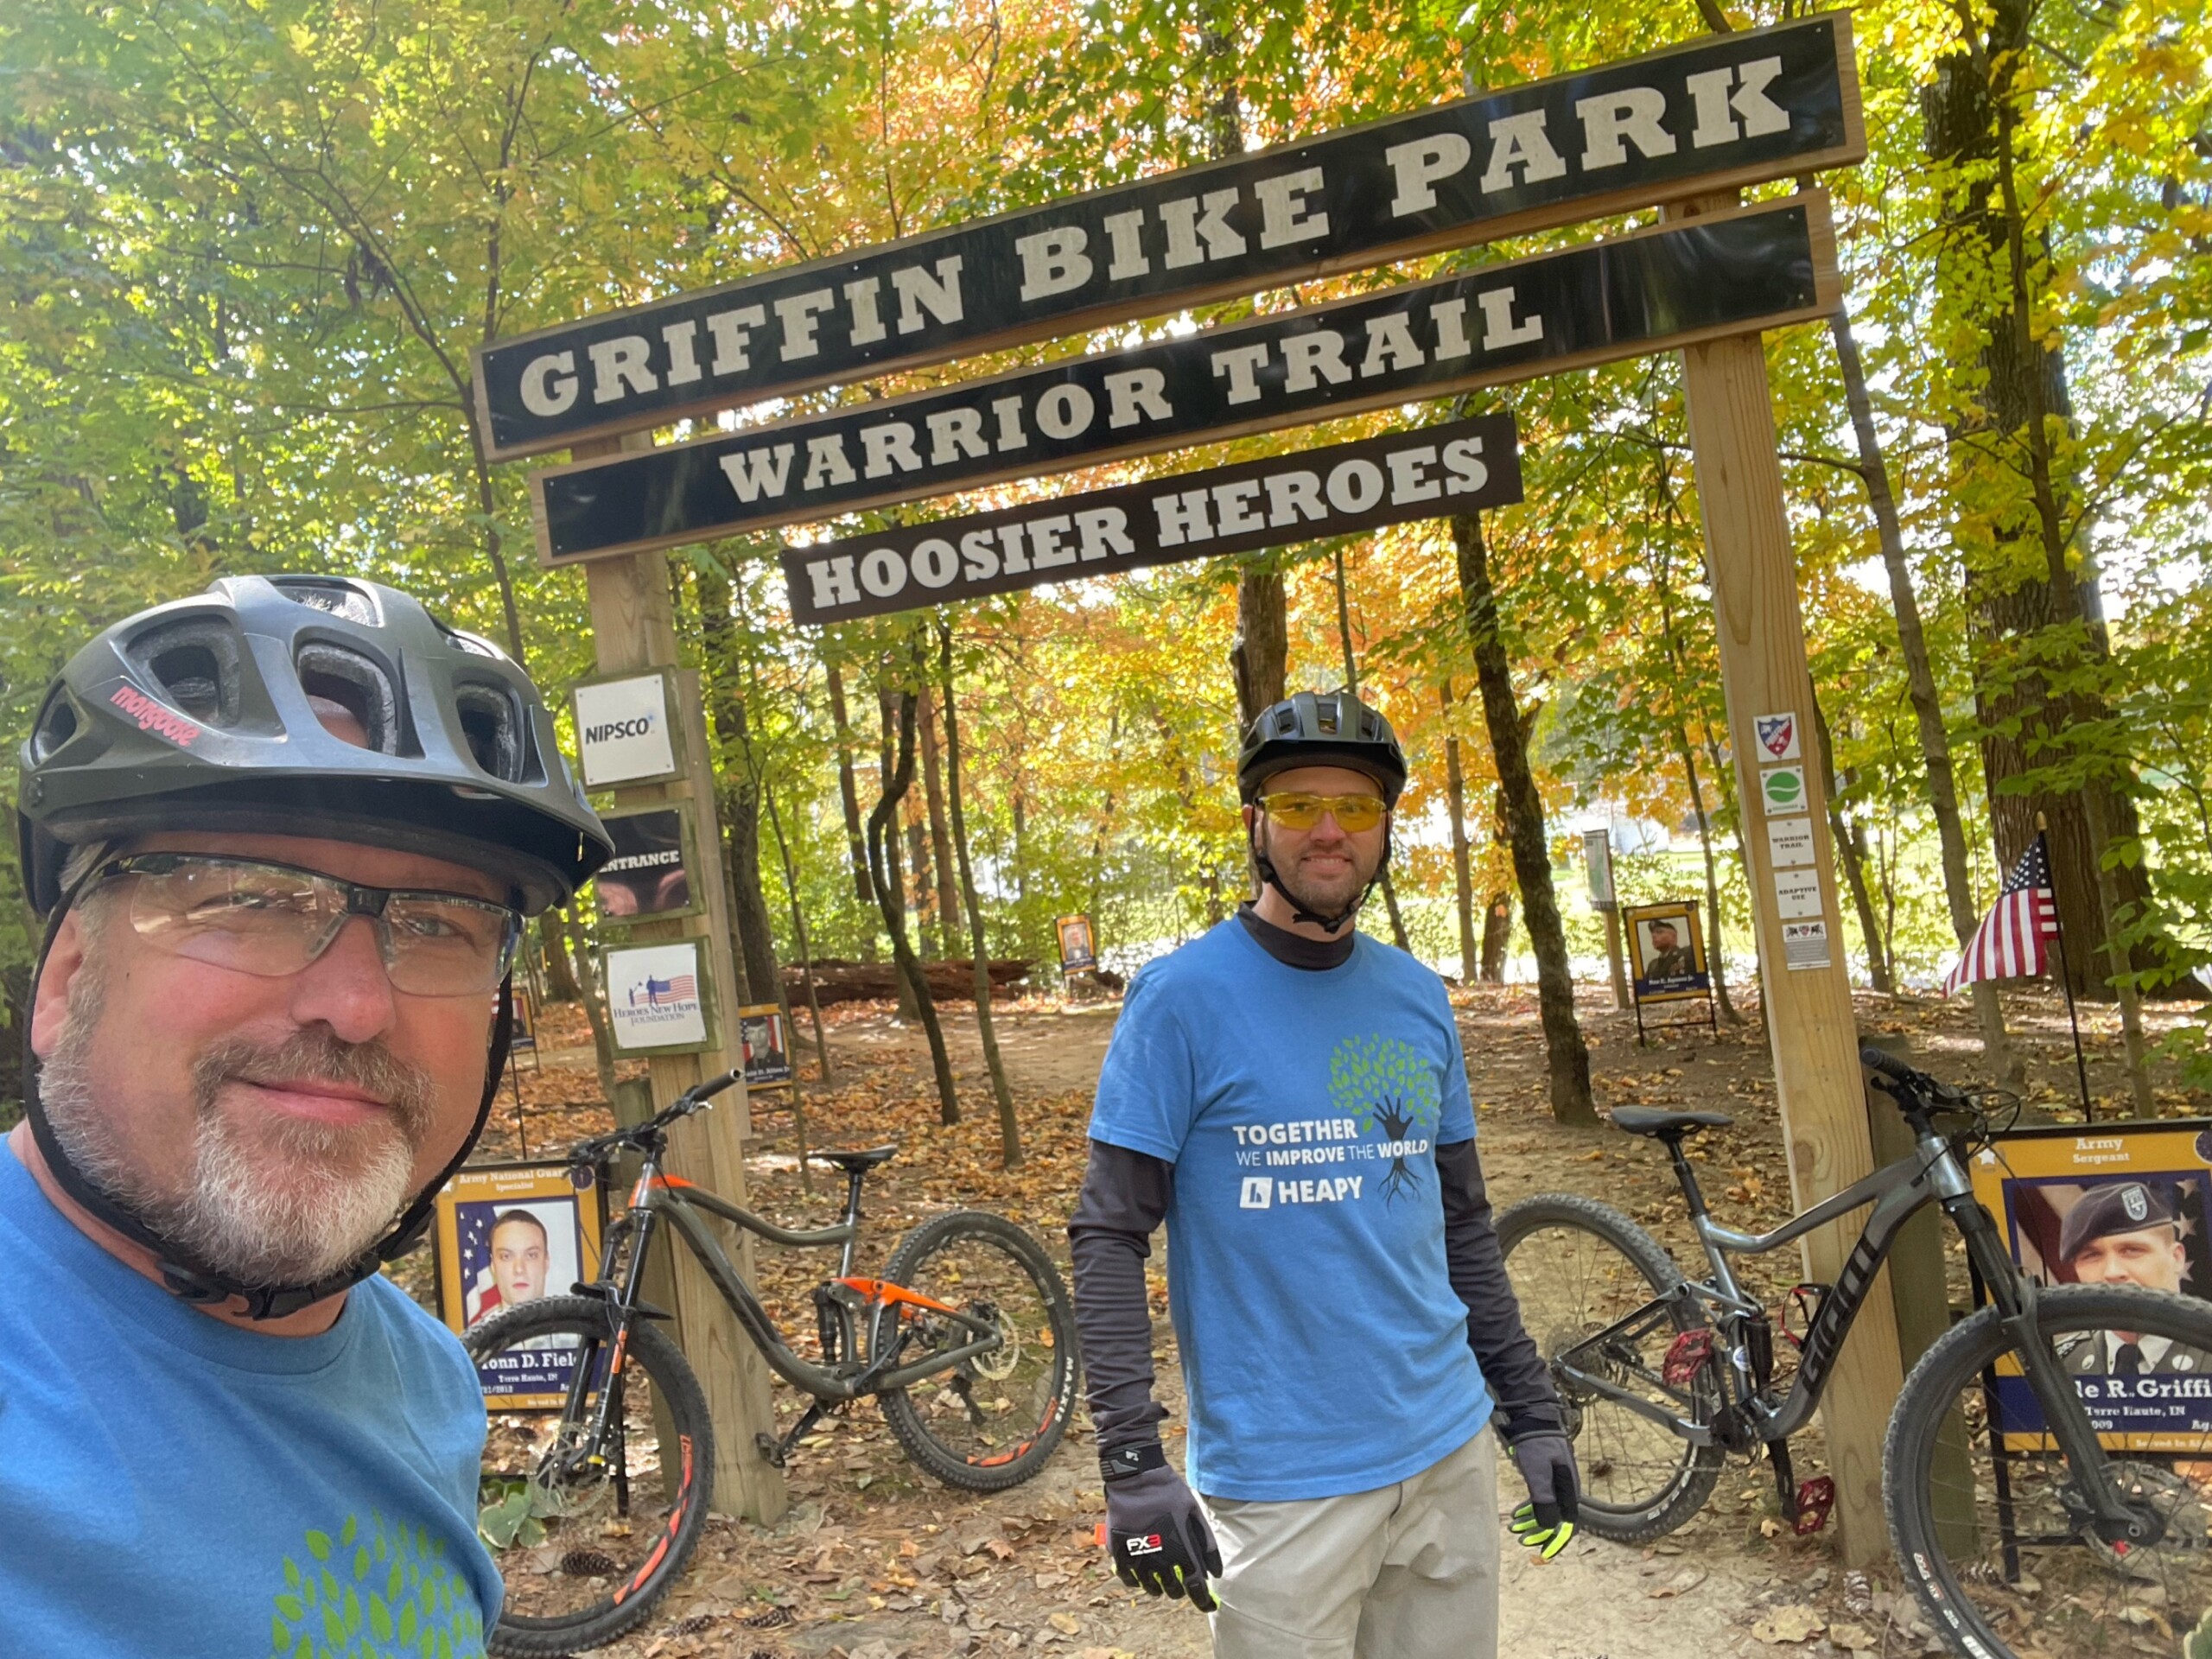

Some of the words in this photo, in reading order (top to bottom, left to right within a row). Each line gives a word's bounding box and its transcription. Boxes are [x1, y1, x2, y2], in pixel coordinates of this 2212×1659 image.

[520, 256, 963, 416] GRIFFIN
[1015, 167, 1331, 302] BIKE
[1386, 56, 1789, 217] PARK
[721, 368, 1173, 505] WARRIOR
[1212, 287, 1544, 405] TRAIL
[806, 506, 1135, 609] HOOSIER
[1153, 437, 1489, 548] HEROES
[110, 685, 200, 747] mongoose
[585, 718, 650, 744] NIPSCO
[1772, 835, 1809, 843] WARRIOR
[1779, 887, 1817, 895] ADAPTIVE
[651, 1005, 671, 1015] NEW
[672, 1002, 698, 1013] HOPE
[631, 1013, 685, 1027] FOUNDATION
[1232, 1119, 1358, 1145] TOGETHER
[1236, 1151, 1261, 1166] WE
[1266, 1146, 1344, 1166] IMPROVE
[1347, 1144, 1375, 1160] THE
[1377, 1139, 1428, 1159] WORLD
[2075, 1138, 2123, 1151] Army
[2073, 1153, 2130, 1165] Sergeant
[460, 1174, 487, 1185] Army
[490, 1169, 534, 1182] National
[496, 1182, 534, 1192] Specialist
[1278, 1176, 1363, 1204] HEAPY
[521, 1354, 539, 1368] D.
[541, 1352, 577, 1368] Fiel
[1054, 1356, 1074, 1423] MAXXIS
[2084, 1407, 2120, 1416] Terre
[2123, 1407, 2166, 1417] Haute,
[2169, 1406, 2185, 1416] IN
[2191, 1420, 2212, 1432] Ag
[1127, 1534, 1161, 1552] FX3
